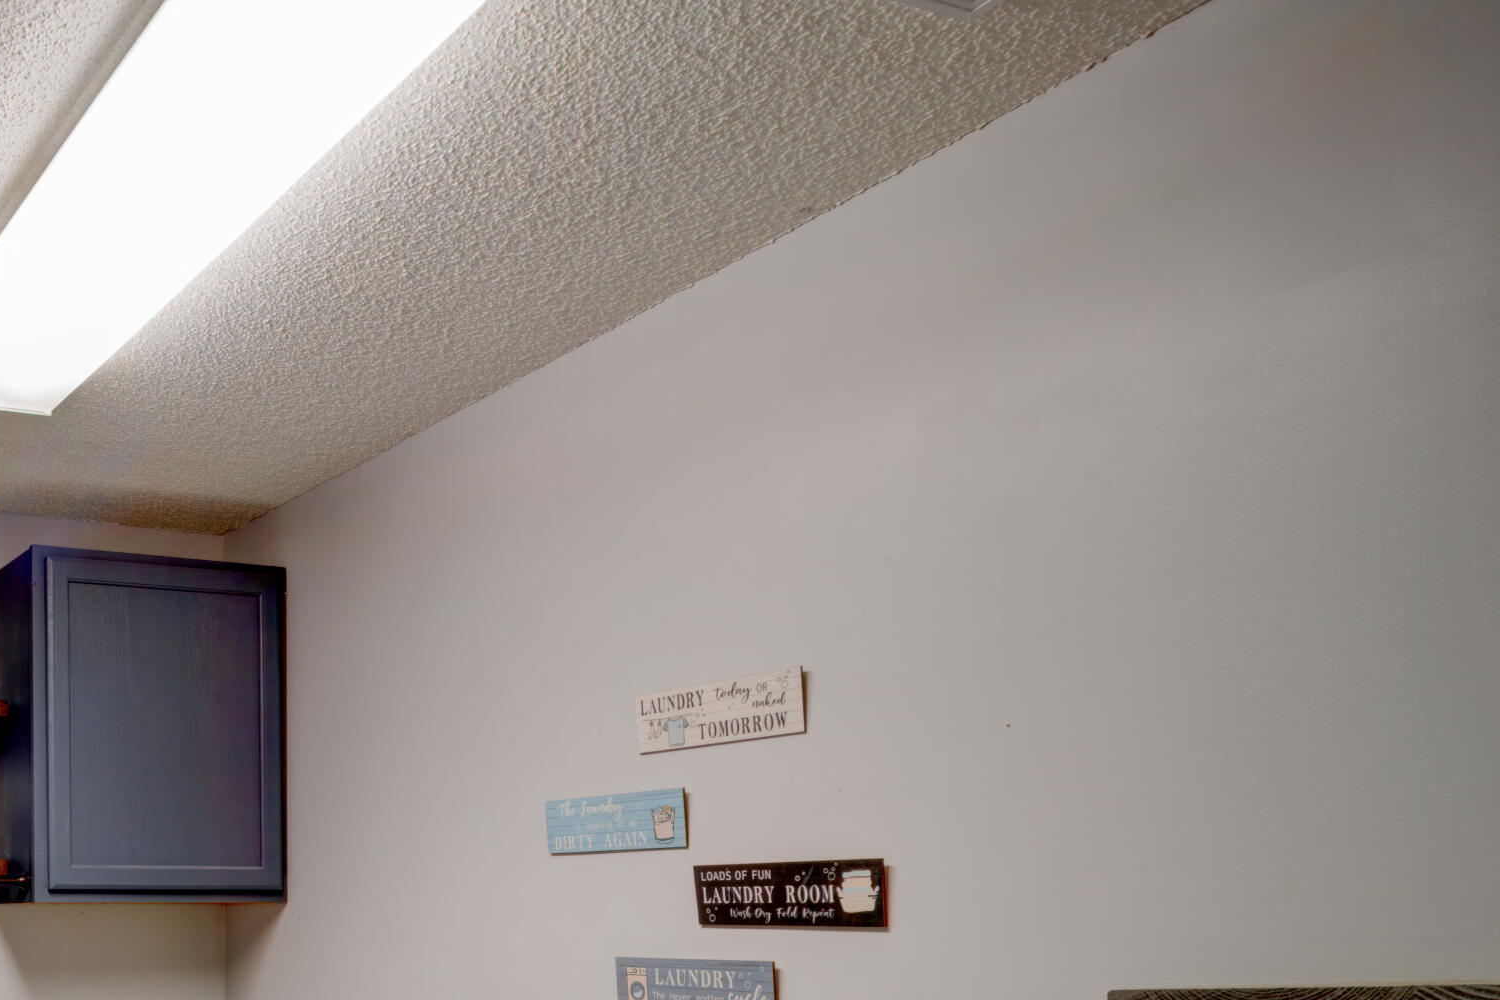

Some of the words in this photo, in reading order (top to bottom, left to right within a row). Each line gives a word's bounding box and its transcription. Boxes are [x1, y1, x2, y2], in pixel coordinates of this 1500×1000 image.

[641, 690, 704, 716] LAUNDRY
[715, 682, 751, 702] today
[756, 683, 767, 692] OR
[752, 692, 786, 708] naked
[699, 711, 787, 740] TOMORROW
[557, 800, 575, 816] The
[555, 834, 594, 850] DIRTY
[604, 831, 648, 848] AGAIN
[701, 871, 731, 881] LOADS
[735, 870, 747, 880] OF
[752, 870, 771, 880] FUN
[702, 886, 774, 904] LAUNDRY
[785, 885, 834, 903] ROOM
[730, 907, 751, 918] Wash
[754, 908, 772, 924] Dry
[776, 906, 798, 918] Fold
[802, 908, 835, 924] Repeat
[655, 968, 736, 988] LAUNDRY
